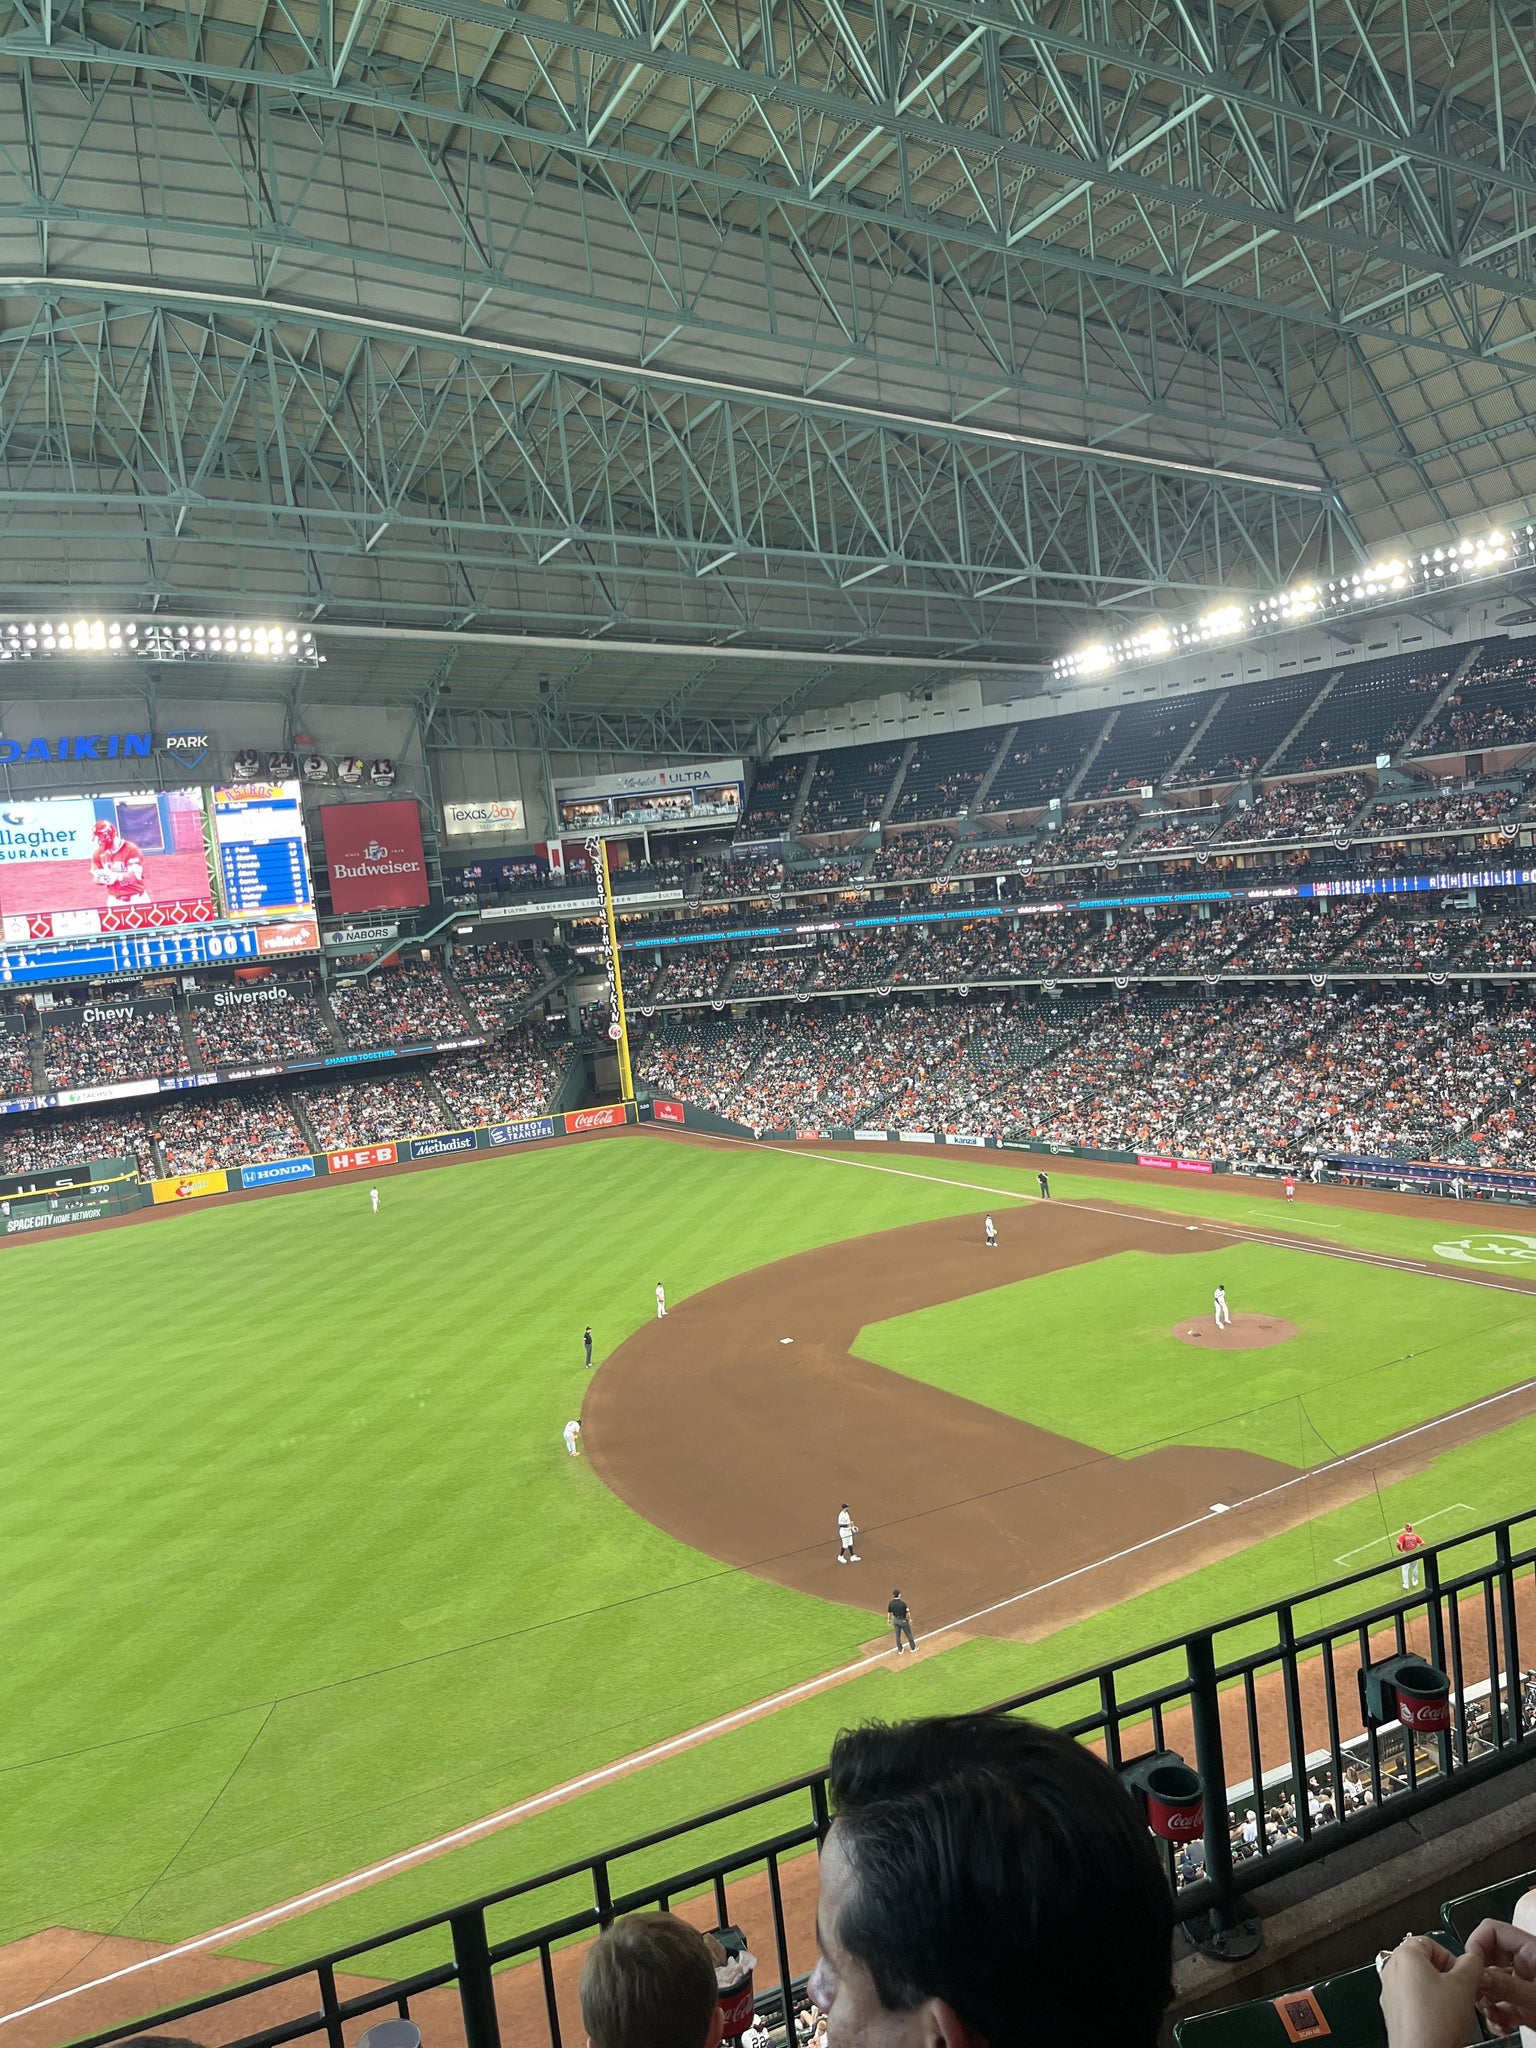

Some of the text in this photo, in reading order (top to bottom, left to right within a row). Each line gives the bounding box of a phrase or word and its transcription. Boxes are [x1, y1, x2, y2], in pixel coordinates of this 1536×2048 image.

[0, 732, 209, 764] DAIKIN PARK
[234, 749, 258, 766] 49
[270, 751, 293, 768] 24
[310, 754, 321, 770] 5
[344, 757, 354, 772] 7
[374, 759, 392, 775] 13
[669, 770, 711, 783] ULTRA
[225, 784, 273, 801] ASTROS
[451, 804, 517, 821] Texas Bay
[0, 848, 69, 860] SURANCE
[333, 859, 420, 879] Budweiser
[1429, 878, 1436, 887] R
[1450, 877, 1458, 886] H
[1473, 876, 1479, 885] E
[1495, 875, 1501, 883] L
[1522, 872, 1530, 881] B
[346, 928, 389, 940] NABORS
[208, 938, 223, 956] 0
[223, 935, 238, 954] 0
[239, 934, 251, 952] 1
[107, 976, 143, 984] CHEVROLET
[214, 986, 288, 1006] Silverado
[605, 959, 620, 1023] CHIKIN
[83, 1006, 134, 1023] Chevy
[325, 1056, 357, 1066] SMARTER
[36, 1095, 48, 1108] K
[82, 1090, 113, 1099] TACHUS
[506, 1121, 542, 1134] ENERGY
[507, 1127, 552, 1141] TRANSFER
[416, 1138, 471, 1156] Methodist
[257, 1163, 313, 1180] HONDA
[89, 1185, 110, 1194] 370
[7, 1208, 101, 1232] SPACE CITY HOME NETWORK
[751, 2035, 767, 2048] 22
